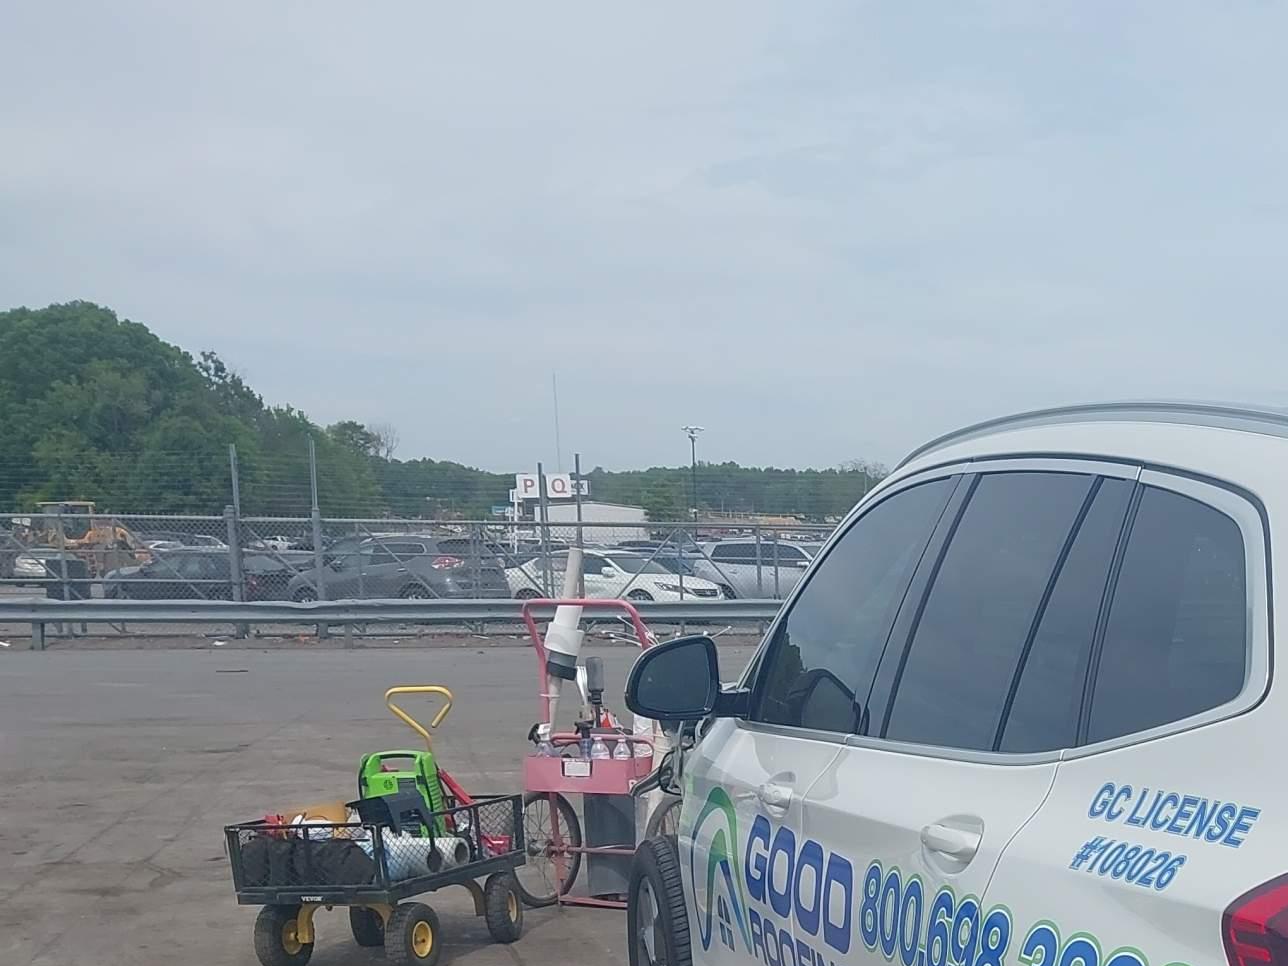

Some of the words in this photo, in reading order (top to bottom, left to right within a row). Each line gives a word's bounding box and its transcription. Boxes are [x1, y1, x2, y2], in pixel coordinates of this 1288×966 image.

[523, 478, 535, 493] P
[551, 478, 567, 494] Q
[1088, 782, 1133, 822] GC
[1124, 788, 1262, 849] LICENSE
[744, 812, 854, 956] GOOD
[1069, 835, 1187, 890] #108026
